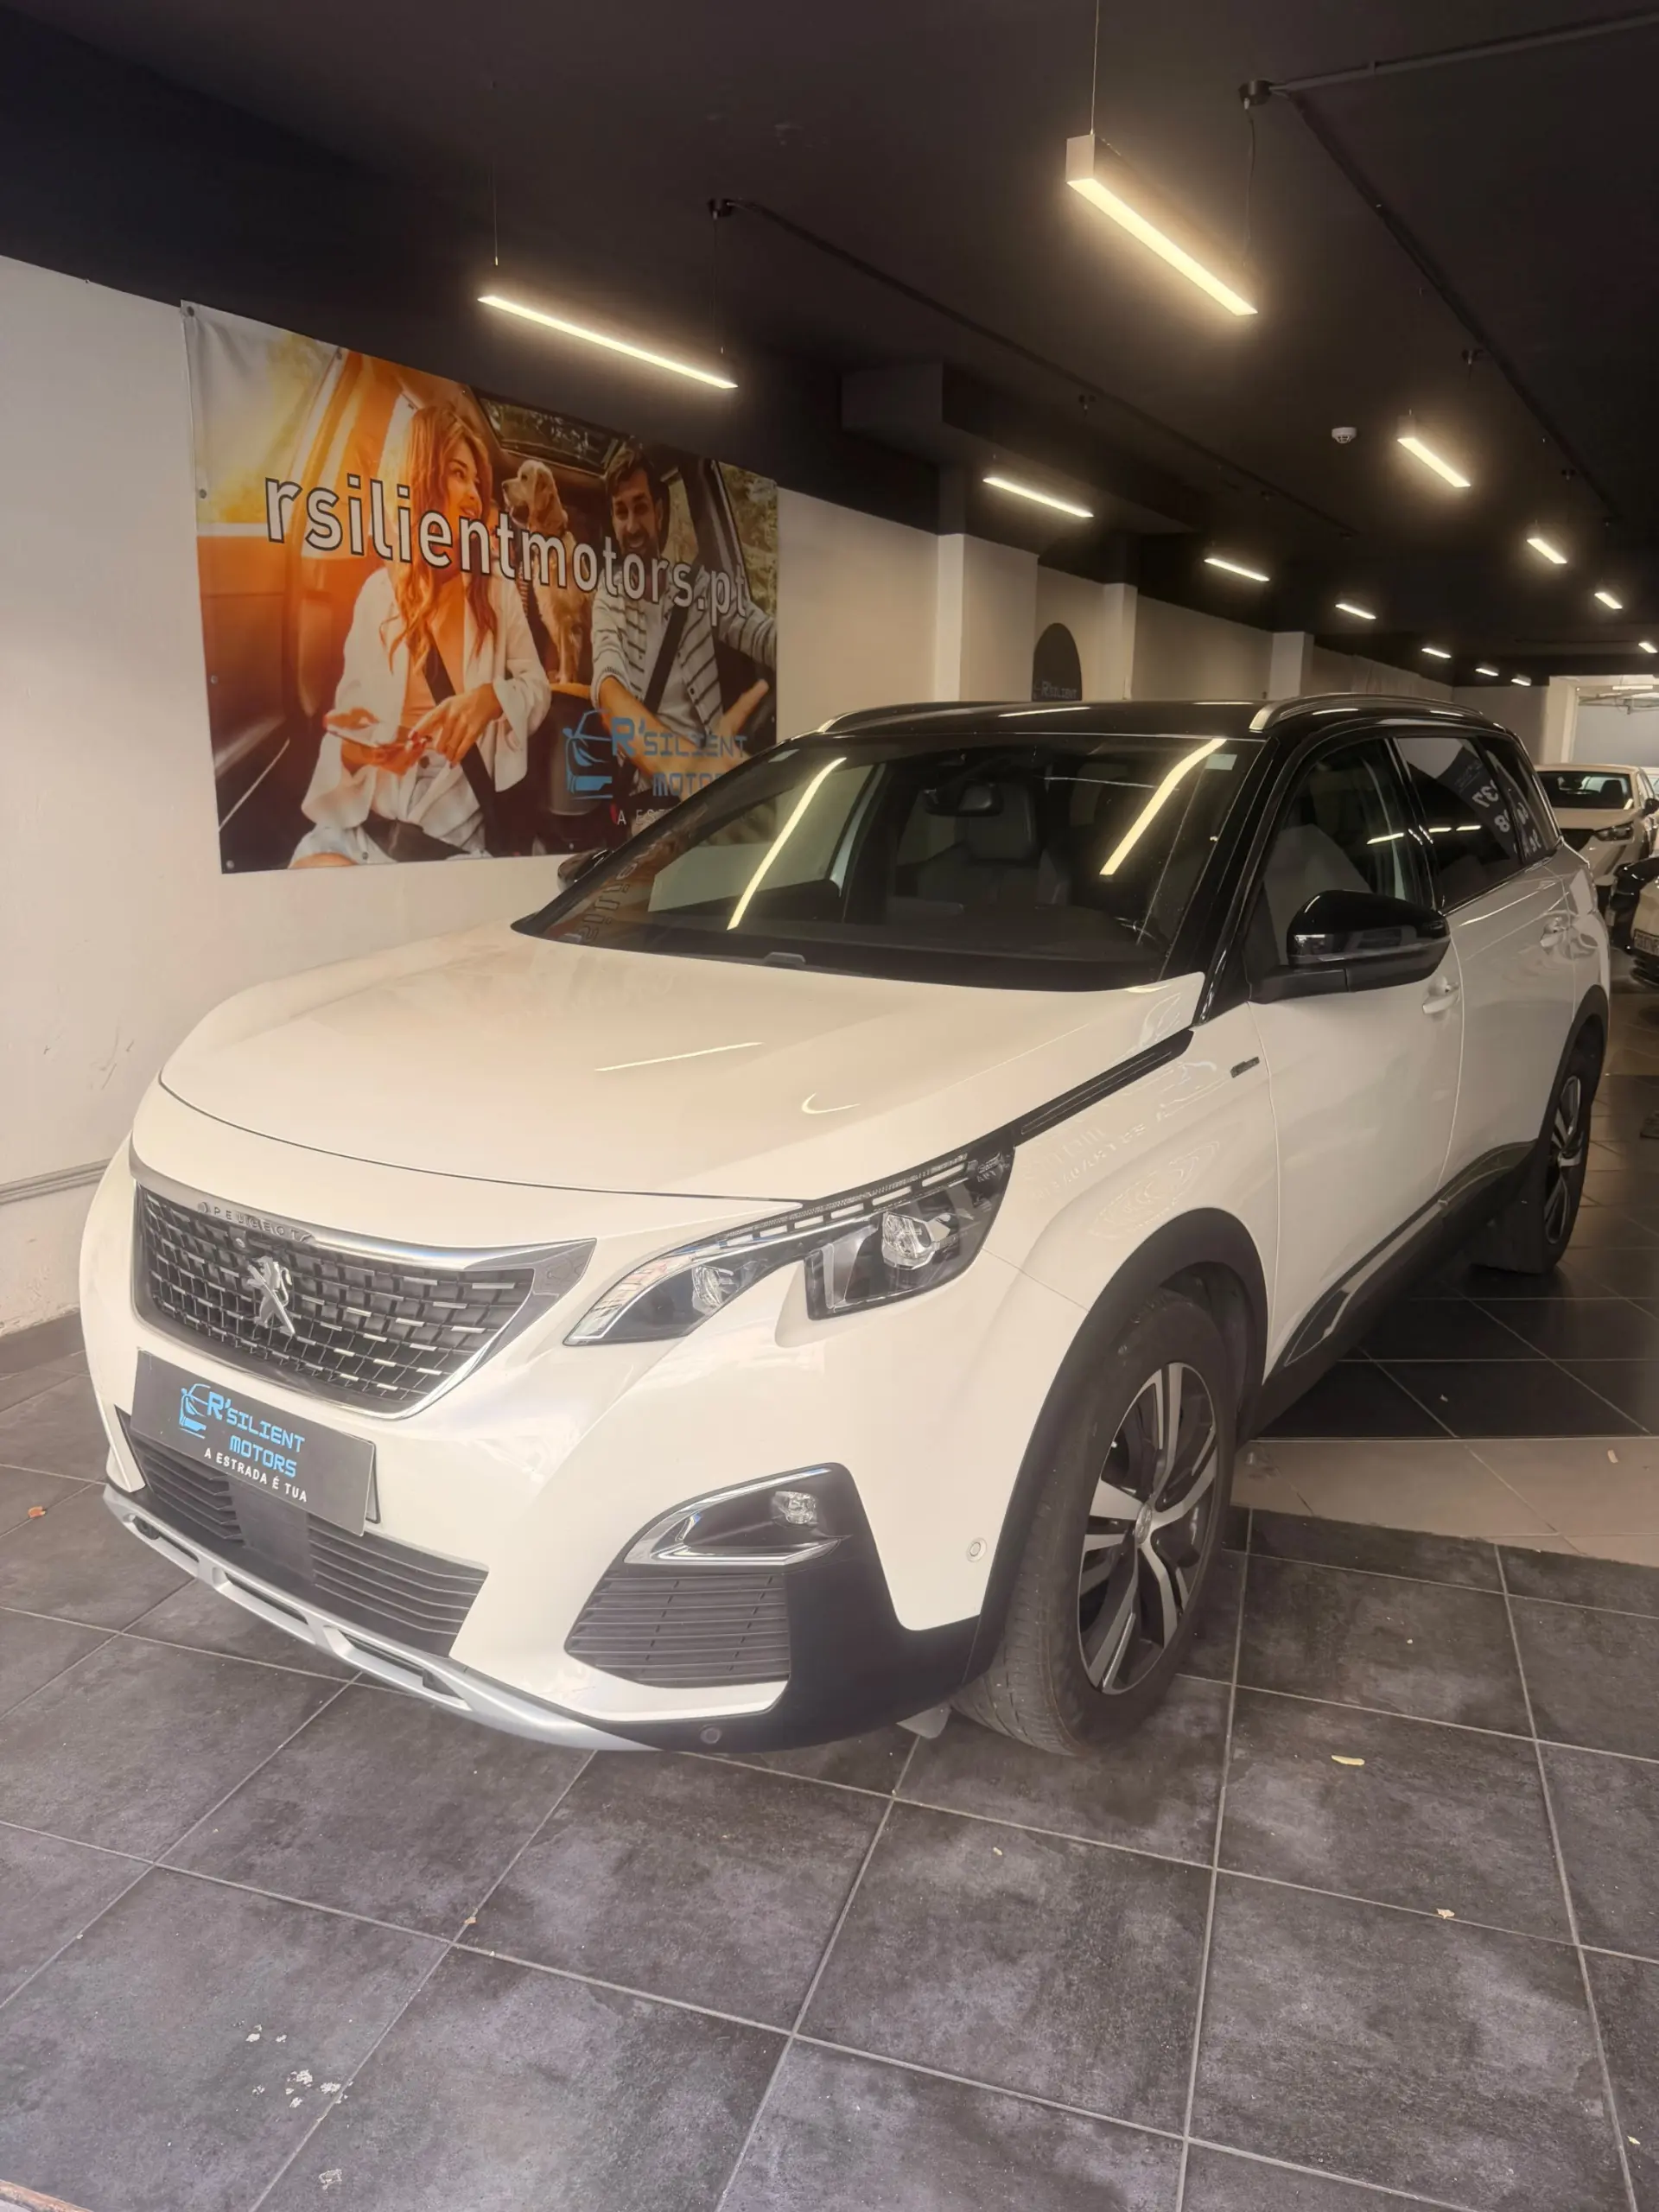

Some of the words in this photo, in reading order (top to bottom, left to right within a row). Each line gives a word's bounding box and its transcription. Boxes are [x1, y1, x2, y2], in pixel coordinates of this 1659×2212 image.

[265, 473, 747, 627] rsilientmotors.pt
[653, 772, 724, 797] MOTO
[213, 1206, 299, 1240] PEUGEOT
[207, 1391, 305, 1452] R'SILIENT
[204, 1447, 212, 1459] A
[216, 1452, 267, 1484] ESTRADA
[272, 1476, 280, 1490] É
[284, 1483, 307, 1503] TUA
[229, 1435, 296, 1478] MOTORS
